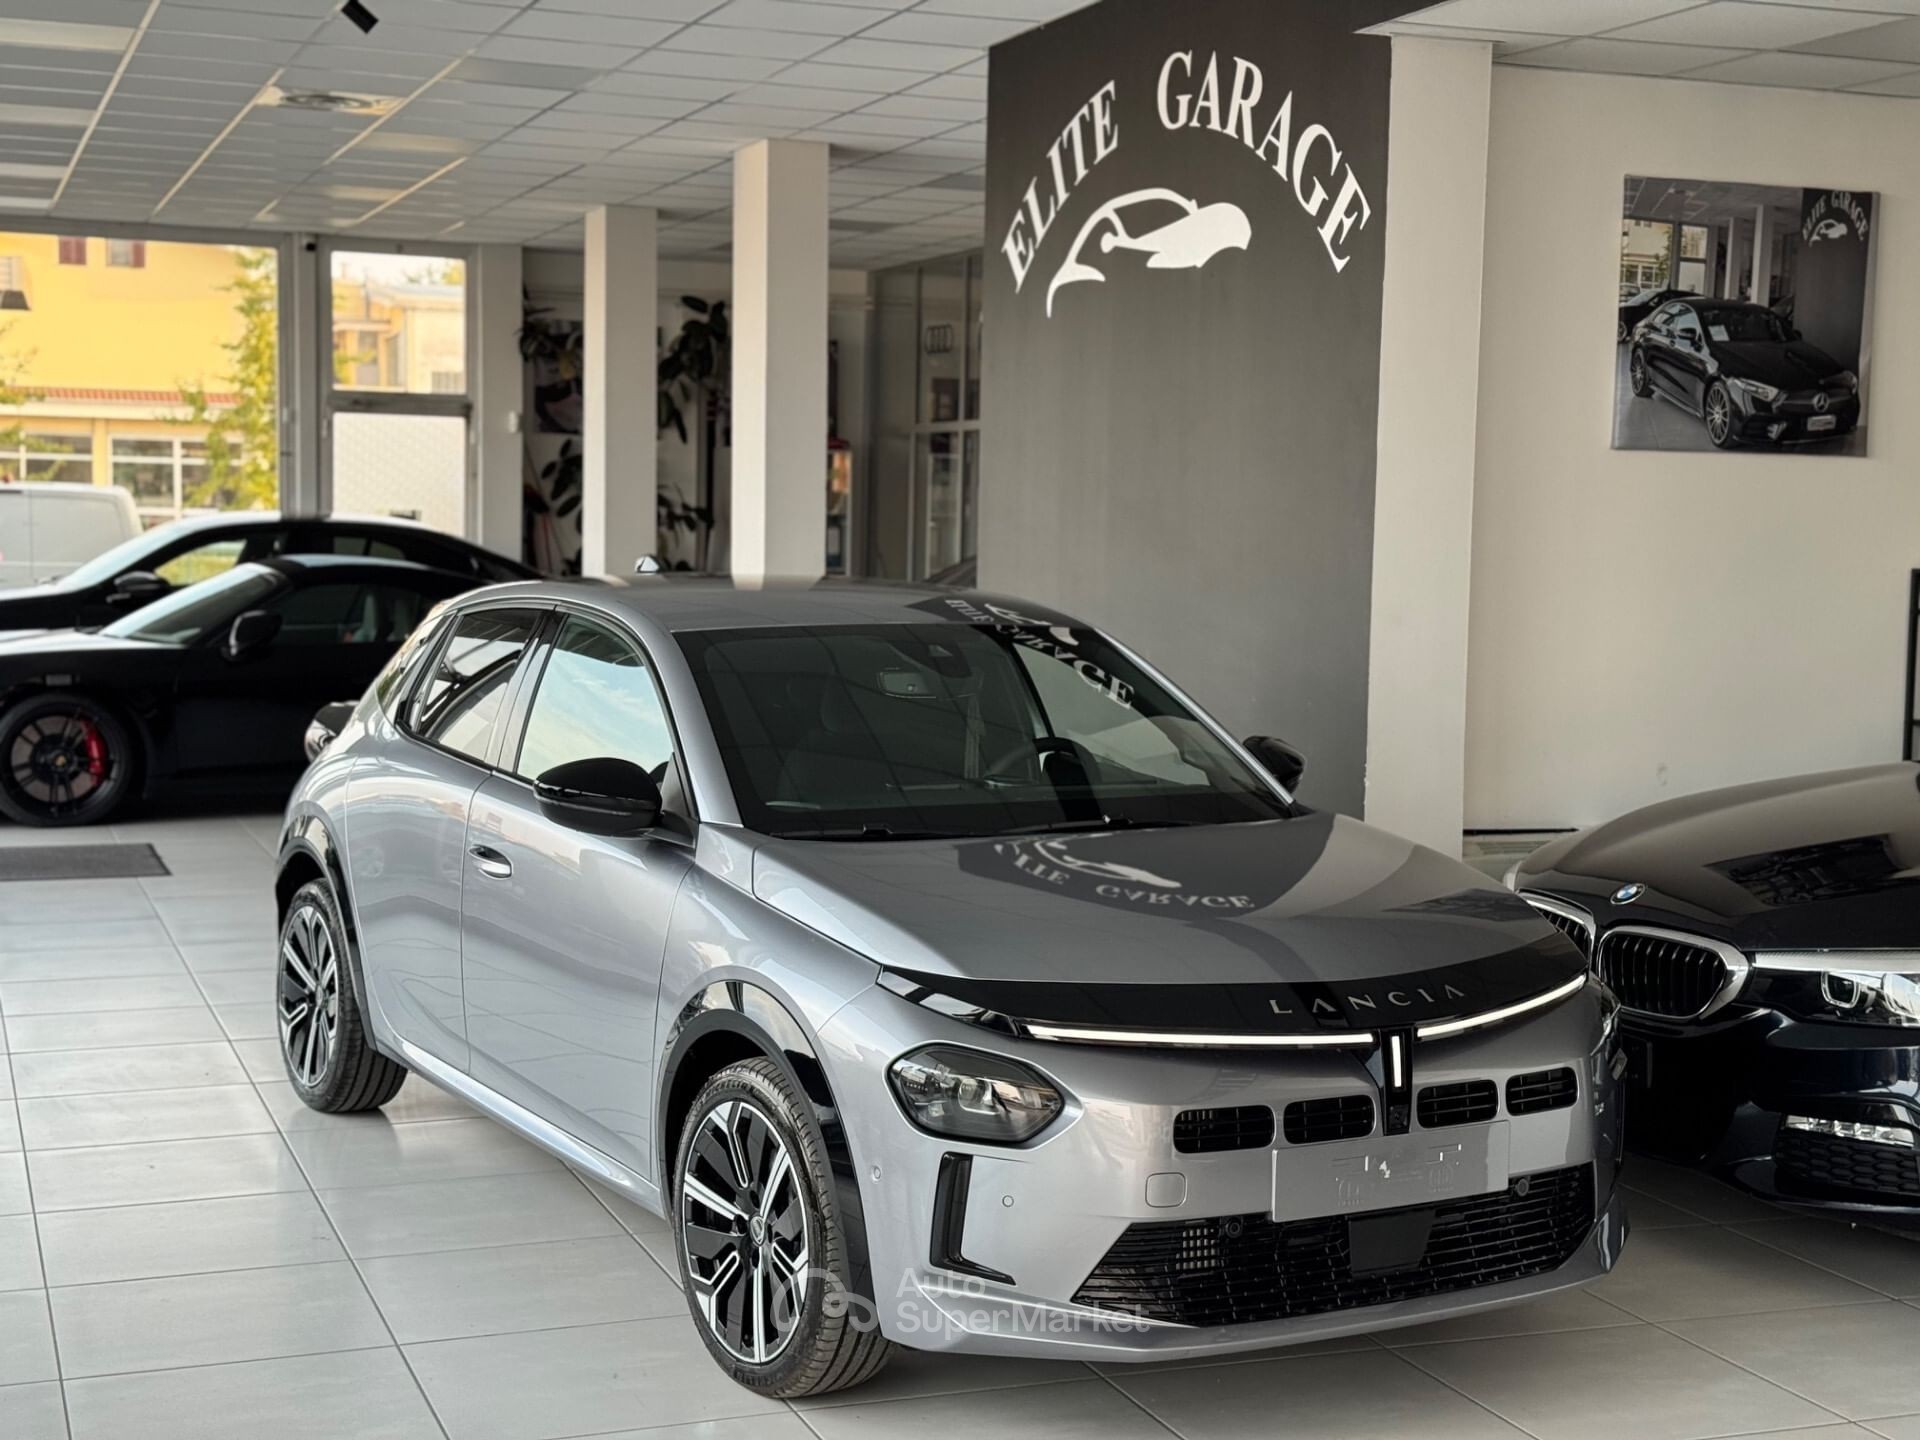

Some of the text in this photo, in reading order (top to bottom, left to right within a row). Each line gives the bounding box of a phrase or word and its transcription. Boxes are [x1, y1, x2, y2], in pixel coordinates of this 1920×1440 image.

[1001, 50, 1372, 294] ELITE GARAGE
[1268, 984, 1465, 1014] LANCIA
